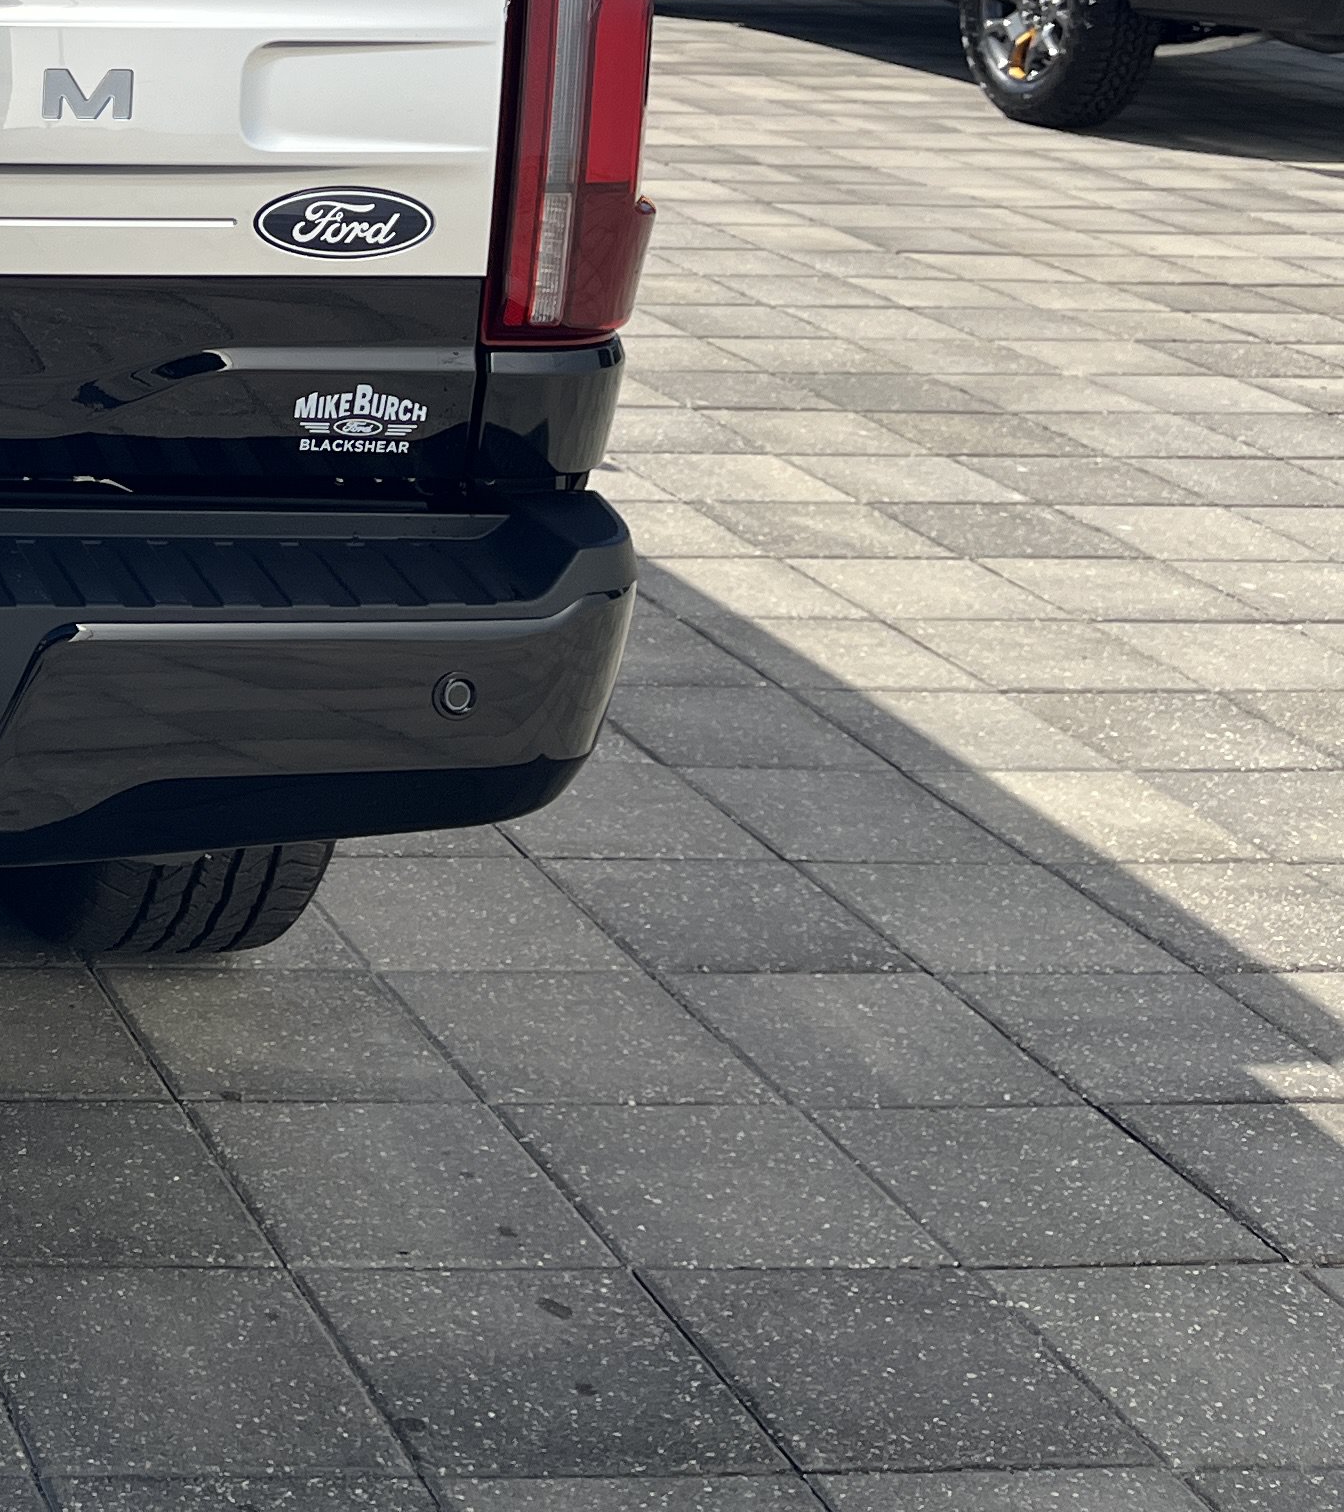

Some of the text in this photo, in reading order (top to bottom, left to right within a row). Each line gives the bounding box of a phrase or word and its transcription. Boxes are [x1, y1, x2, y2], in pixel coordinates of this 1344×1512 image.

[292, 200, 402, 246] Ford
[342, 421, 374, 433] Ford
[299, 439, 410, 454] BLACKSHEAR
